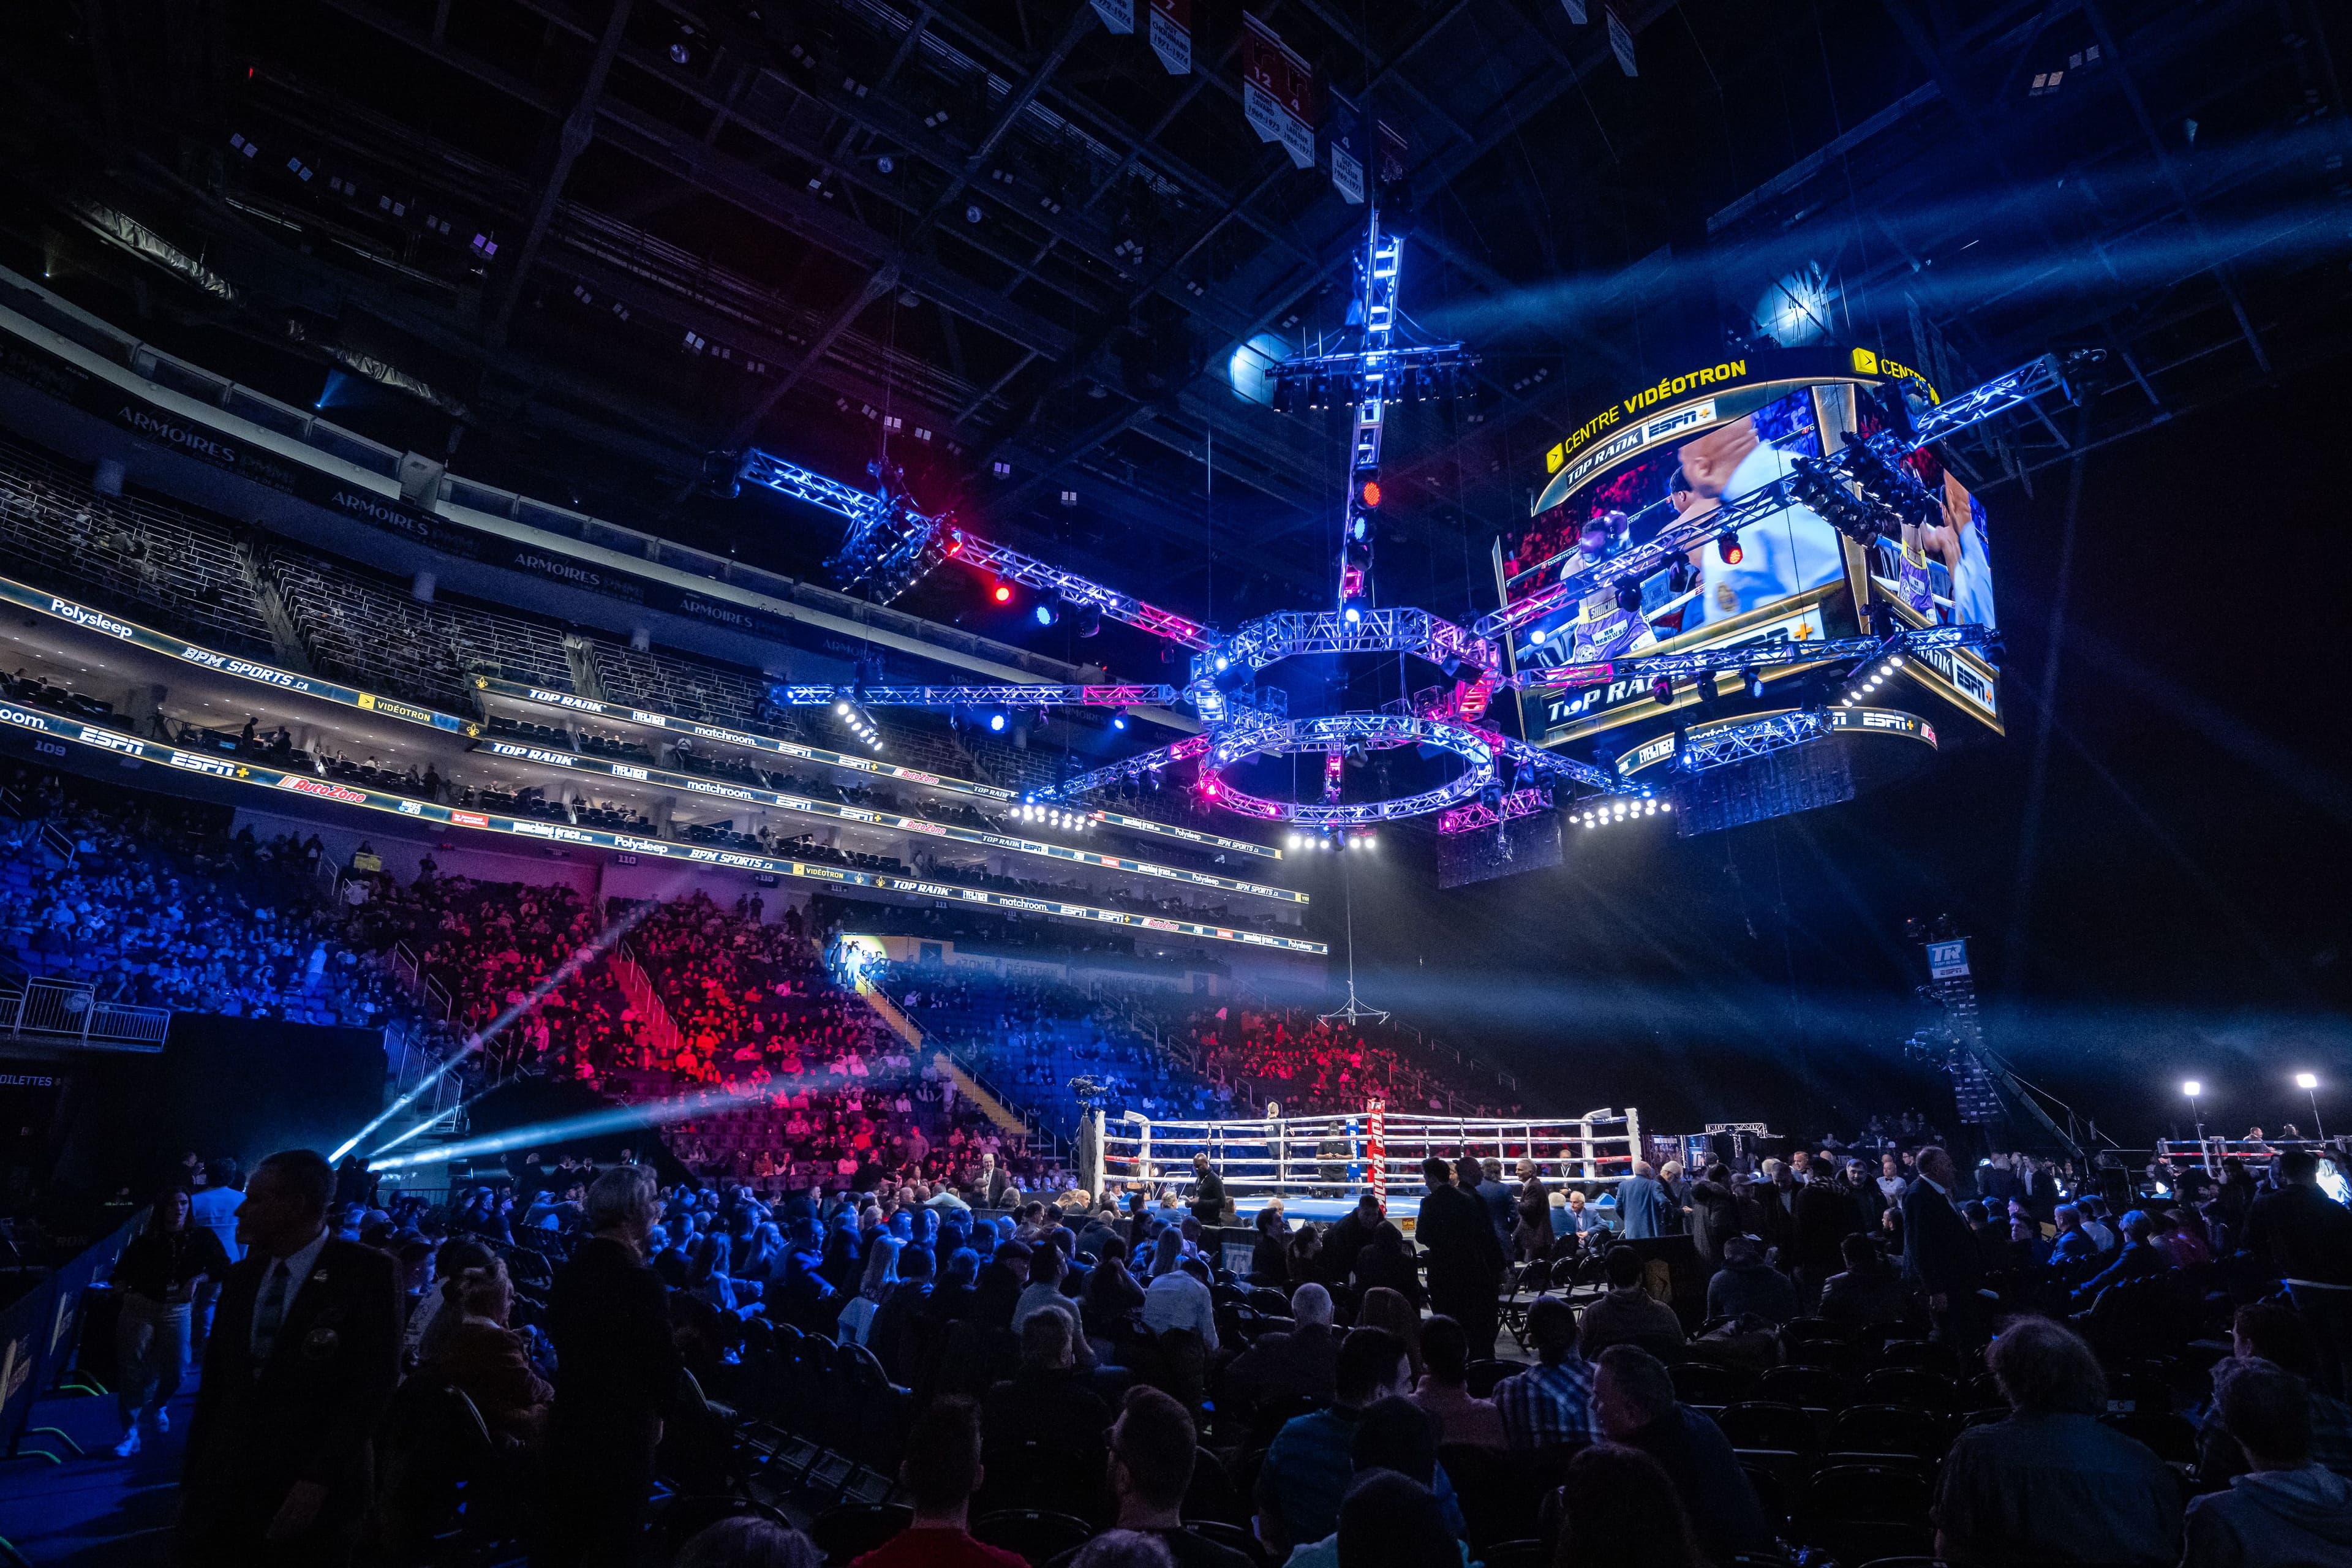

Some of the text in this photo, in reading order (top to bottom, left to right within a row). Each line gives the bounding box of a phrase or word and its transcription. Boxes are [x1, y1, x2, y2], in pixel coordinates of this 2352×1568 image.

[1254, 66, 1272, 88] 12
[1564, 359, 1747, 454] CENTRE VIDÉOTRON
[117, 406, 235, 462] ARMOIRES
[1567, 459, 1593, 485] TOP
[1594, 431, 1641, 467] RANK
[331, 491, 429, 535] ARMOIRES
[514, 552, 600, 585] ARMOIRES
[51, 598, 133, 638] Polysleep
[680, 599, 753, 628] ARMOIRES
[181, 647, 226, 668] BPM
[529, 689, 604, 712] TOP RANK
[0, 709, 48, 730] oom.
[377, 701, 431, 722] VIDÉOTRON
[79, 726, 145, 755] ESPN
[695, 726, 758, 746] matchroom.
[34, 740, 66, 756] 109
[492, 742, 575, 766] TOP RANK
[778, 742, 812, 758] ESPN
[901, 771, 940, 785] AutoZone
[294, 778, 367, 804] AutoZone
[687, 781, 754, 800] matchroom.
[775, 795, 812, 810] ESPN
[907, 821, 947, 835] AutoZone
[1175, 828, 1201, 842] Polysleep
[614, 835, 668, 856] Polysleep
[982, 835, 998, 843] TOP
[999, 839, 1022, 848] RANK
[618, 854, 636, 865] 110
[689, 849, 720, 861] BPM
[806, 867, 844, 879] VIDÉOTRON
[1192, 873, 1219, 886] Polysleep
[894, 880, 917, 892] TOP
[916, 883, 950, 896] RANK
[1000, 897, 1049, 911] matchroom.
[1060, 905, 1087, 917] ESPN
[1148, 919, 1180, 932] AutoZone
[0, 1074, 53, 1087] OILETTES
[1371, 1112, 1384, 1148] TOP
